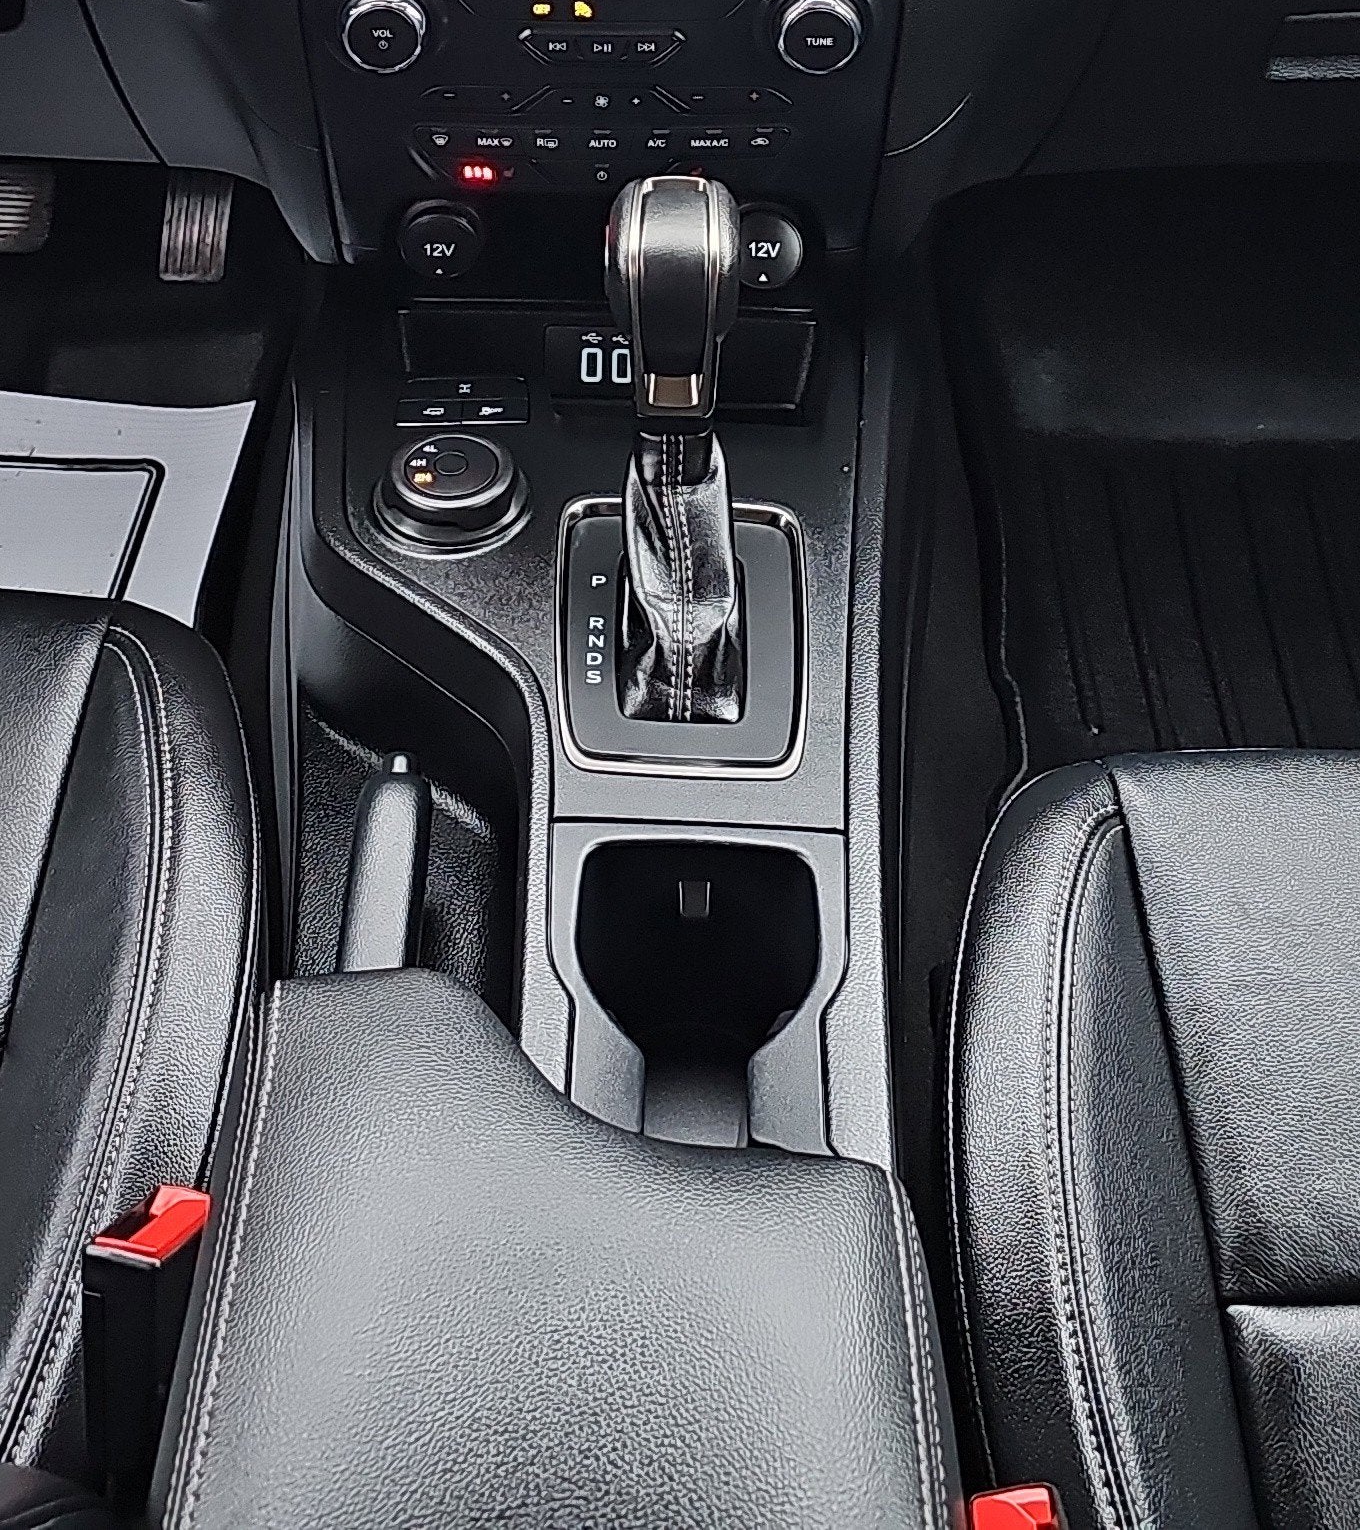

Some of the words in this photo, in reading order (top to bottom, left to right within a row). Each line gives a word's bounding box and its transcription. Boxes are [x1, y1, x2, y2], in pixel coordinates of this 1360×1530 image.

[372, 29, 393, 38] VOL
[805, 37, 834, 47] TUNE
[477, 137, 500, 147] MAX
[589, 138, 617, 148] AUTO
[647, 138, 667, 148] A/C
[690, 139, 712, 148] MAX
[423, 243, 455, 257] 12V
[748, 242, 781, 258] 12V
[422, 444, 439, 453] 4L
[409, 458, 427, 467] 4H
[591, 575, 607, 588] P
[588, 616, 605, 630] R
[588, 634, 605, 648] N
[586, 652, 603, 665] D
[585, 670, 602, 684] S
